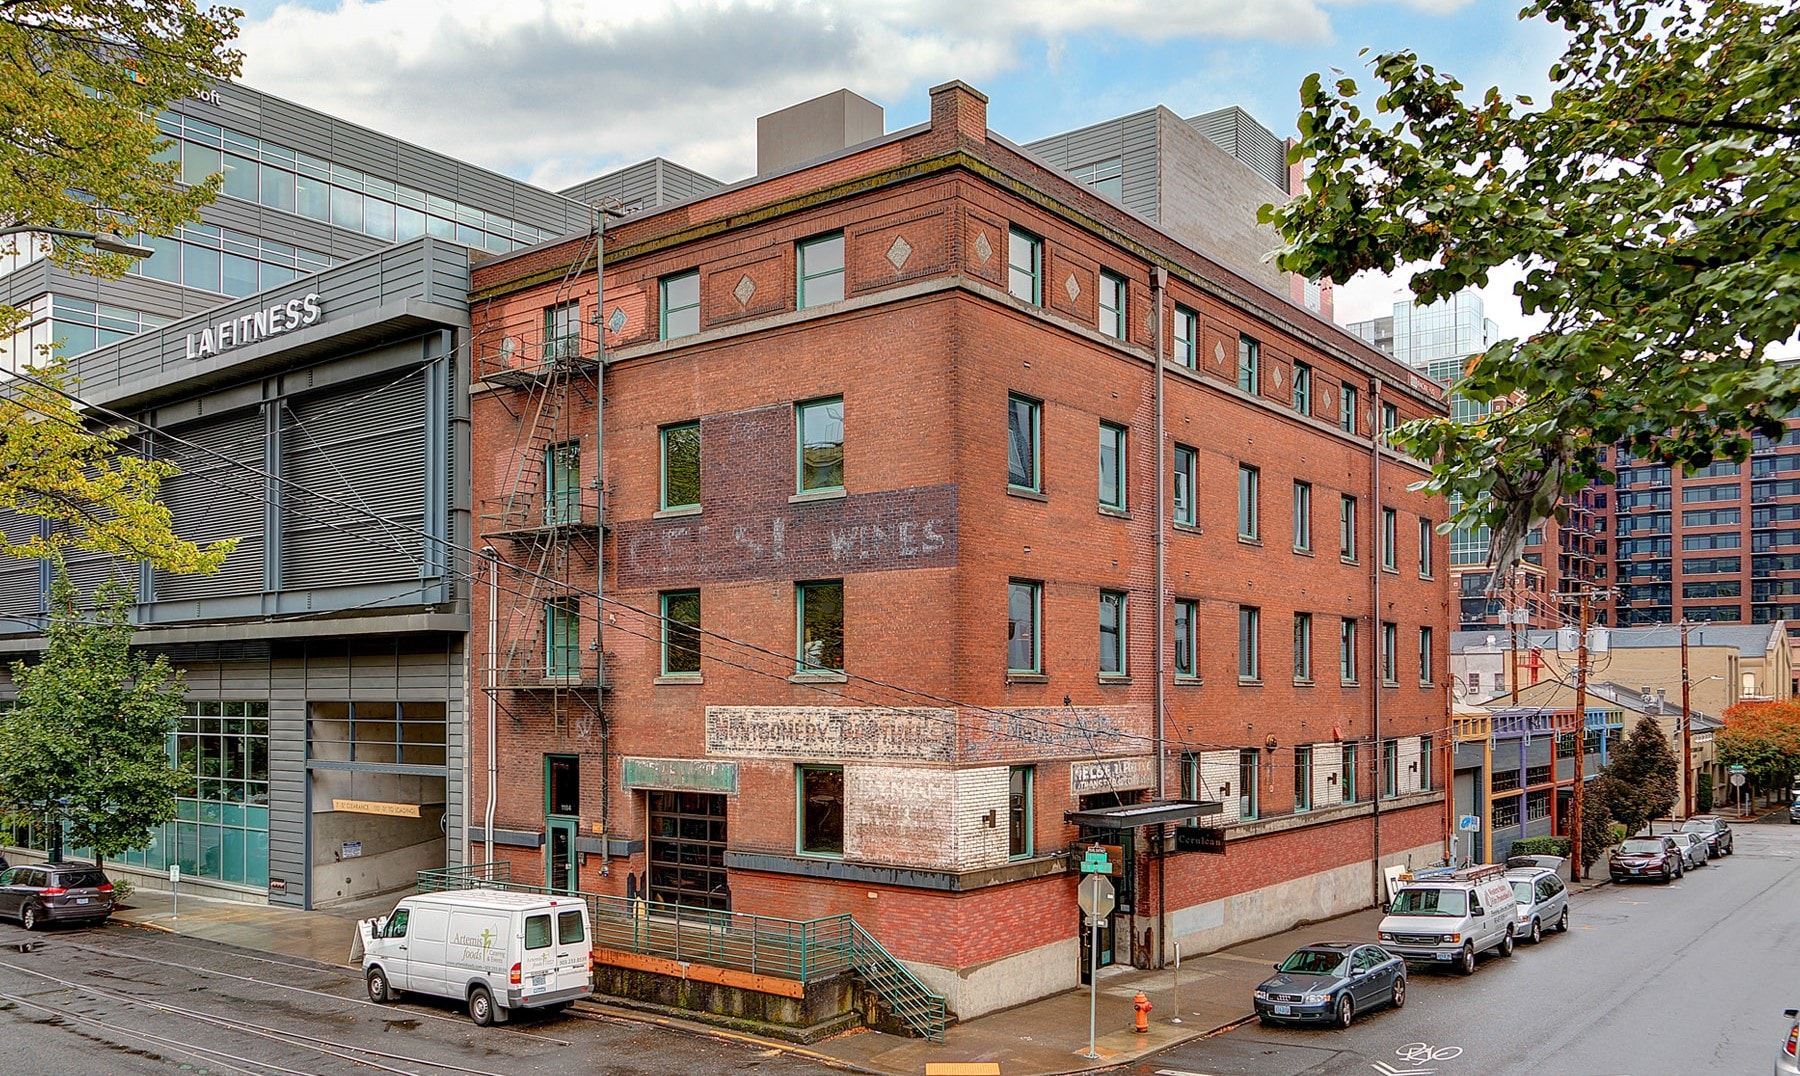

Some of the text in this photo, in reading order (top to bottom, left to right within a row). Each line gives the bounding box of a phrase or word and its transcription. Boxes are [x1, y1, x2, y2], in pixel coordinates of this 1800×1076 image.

[186, 293, 322, 360] LA FITNESS
[1178, 834, 1221, 846] Cerulean
[454, 932, 483, 948] Artemis
[461, 946, 482, 961] foods
